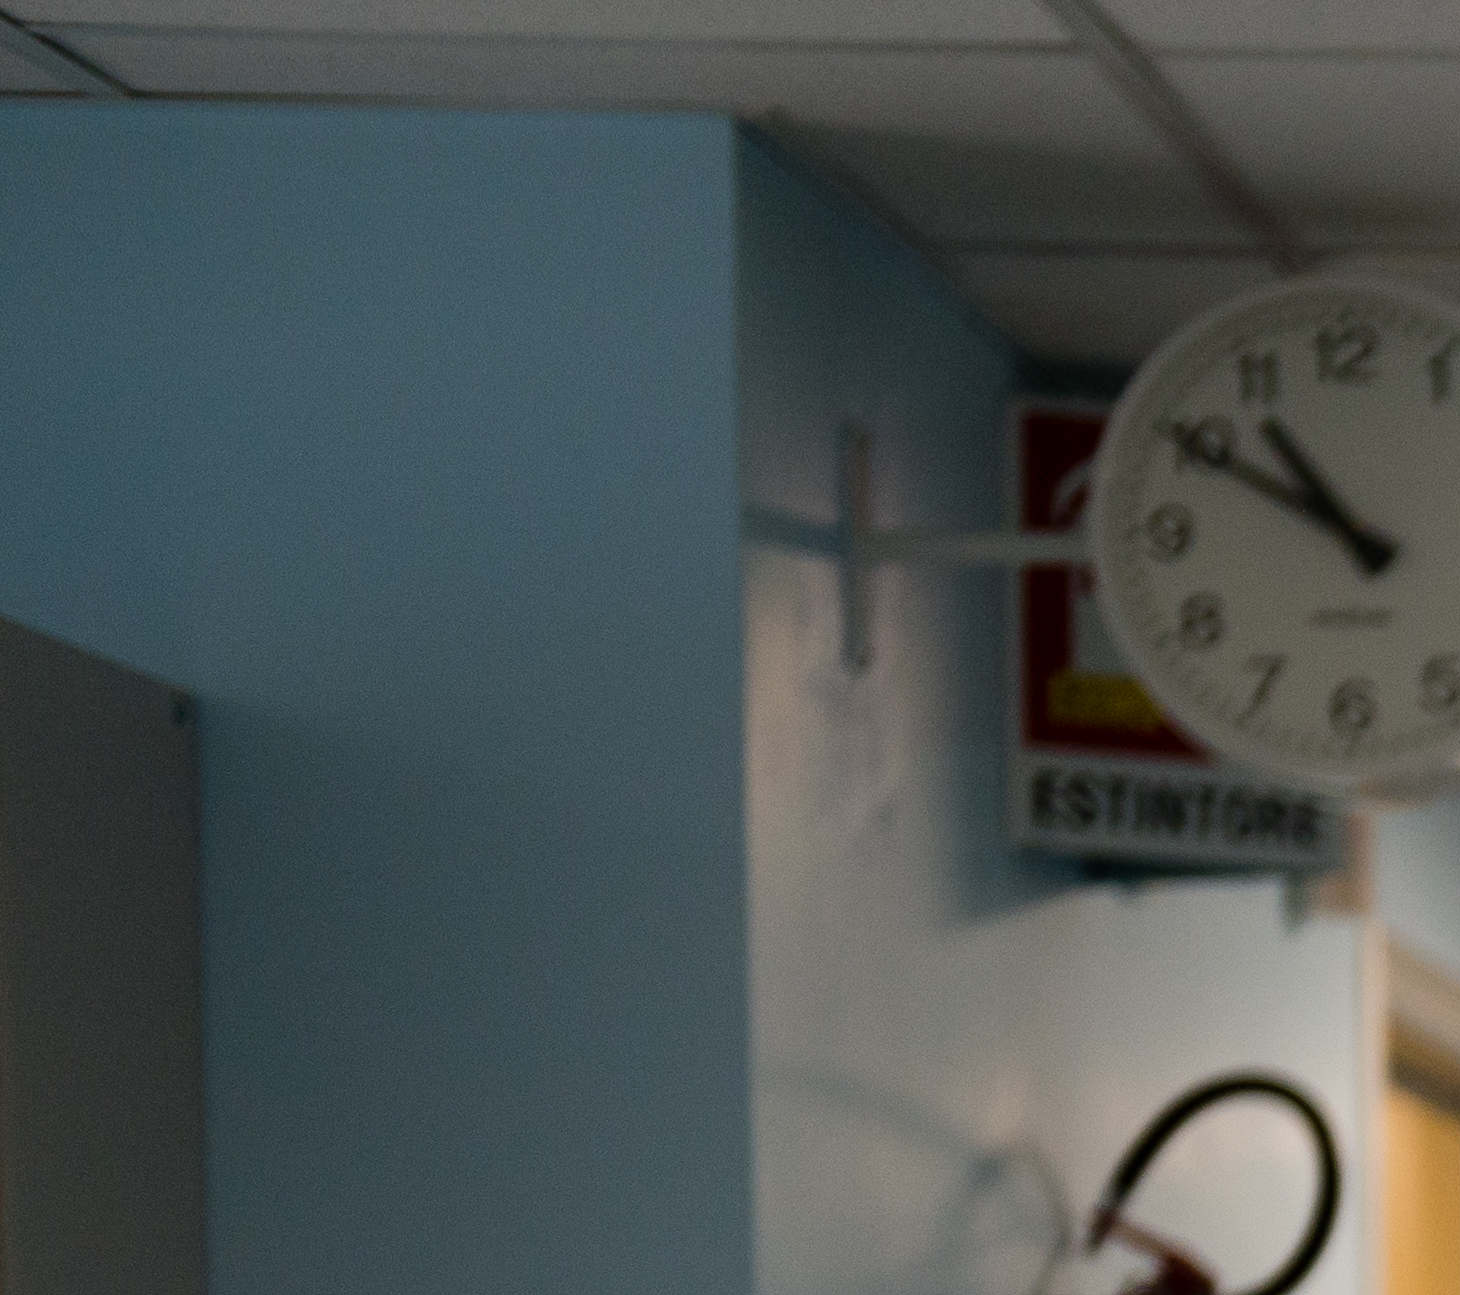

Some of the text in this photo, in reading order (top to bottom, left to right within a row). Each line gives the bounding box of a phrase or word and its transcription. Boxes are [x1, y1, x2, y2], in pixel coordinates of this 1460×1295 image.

[1237, 349, 1279, 401] 11
[1312, 323, 1382, 387] 12
[1425, 346, 1453, 402] 1
[1146, 502, 1193, 562] 9
[1179, 591, 1225, 651] 8
[1244, 654, 1286, 707] 7
[1328, 676, 1377, 736] 6
[1031, 770, 1323, 845] ESTINTORE
